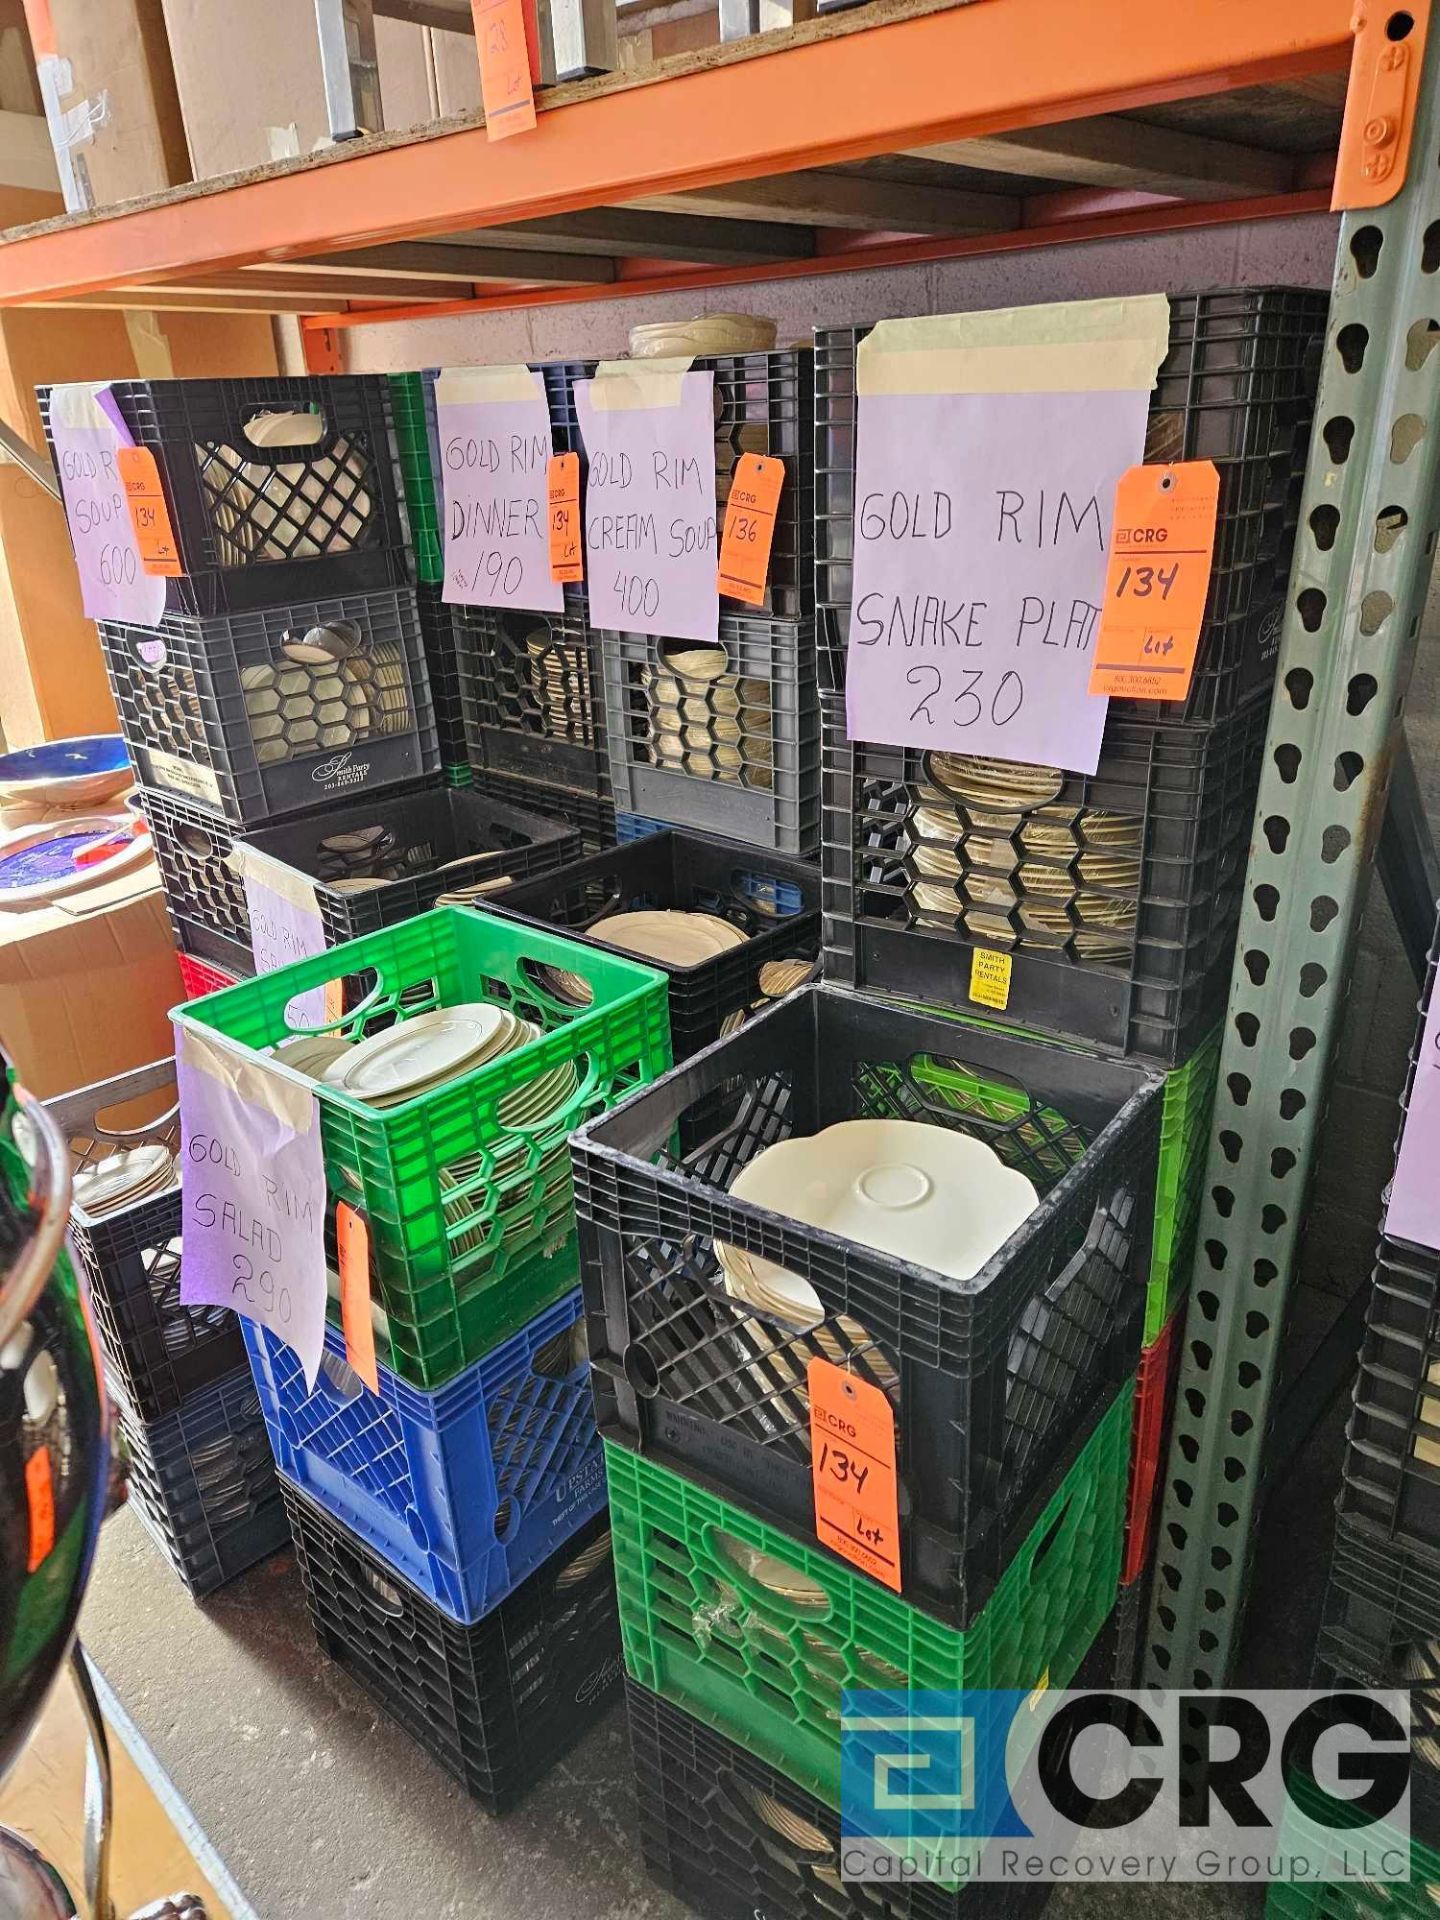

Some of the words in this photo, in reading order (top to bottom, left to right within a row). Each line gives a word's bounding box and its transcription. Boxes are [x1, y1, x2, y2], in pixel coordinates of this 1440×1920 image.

[62, 450, 97, 481] GOLD
[446, 436, 500, 472] GOLD
[510, 434, 548, 474] RIM
[588, 451, 632, 489] GOLD
[653, 450, 704, 495] RIM
[75, 495, 122, 534] SOUP
[135, 507, 155, 527] 134
[451, 498, 544, 541] DINNER
[740, 492, 757, 504] CRG
[552, 510, 569, 537] 134
[588, 513, 658, 555] CREAM
[669, 515, 717, 558] SOUP
[729, 515, 757, 542] 136
[860, 490, 952, 541] GOLD
[996, 490, 1104, 551] RIM
[1133, 528, 1168, 544] CRG
[100, 542, 136, 586] 600
[471, 550, 523, 598] 190
[1116, 562, 1180, 601] 134
[614, 571, 660, 617] 400
[856, 592, 988, 649] SNAKE
[906, 665, 1024, 728] 230
[252, 909, 277, 940] GOLD
[282, 926, 308, 958] RIM
[975, 970, 1008, 985] RENTALS
[978, 961, 1005, 974] PARTY
[980, 951, 1005, 964] SMITH
[189, 1134, 241, 1177] GOLD
[263, 1174, 315, 1234] RIM
[192, 1193, 283, 1263] SALAD
[232, 1254, 293, 1323] 290
[828, 1414, 857, 1438] CRG
[819, 1443, 869, 1494] 134
